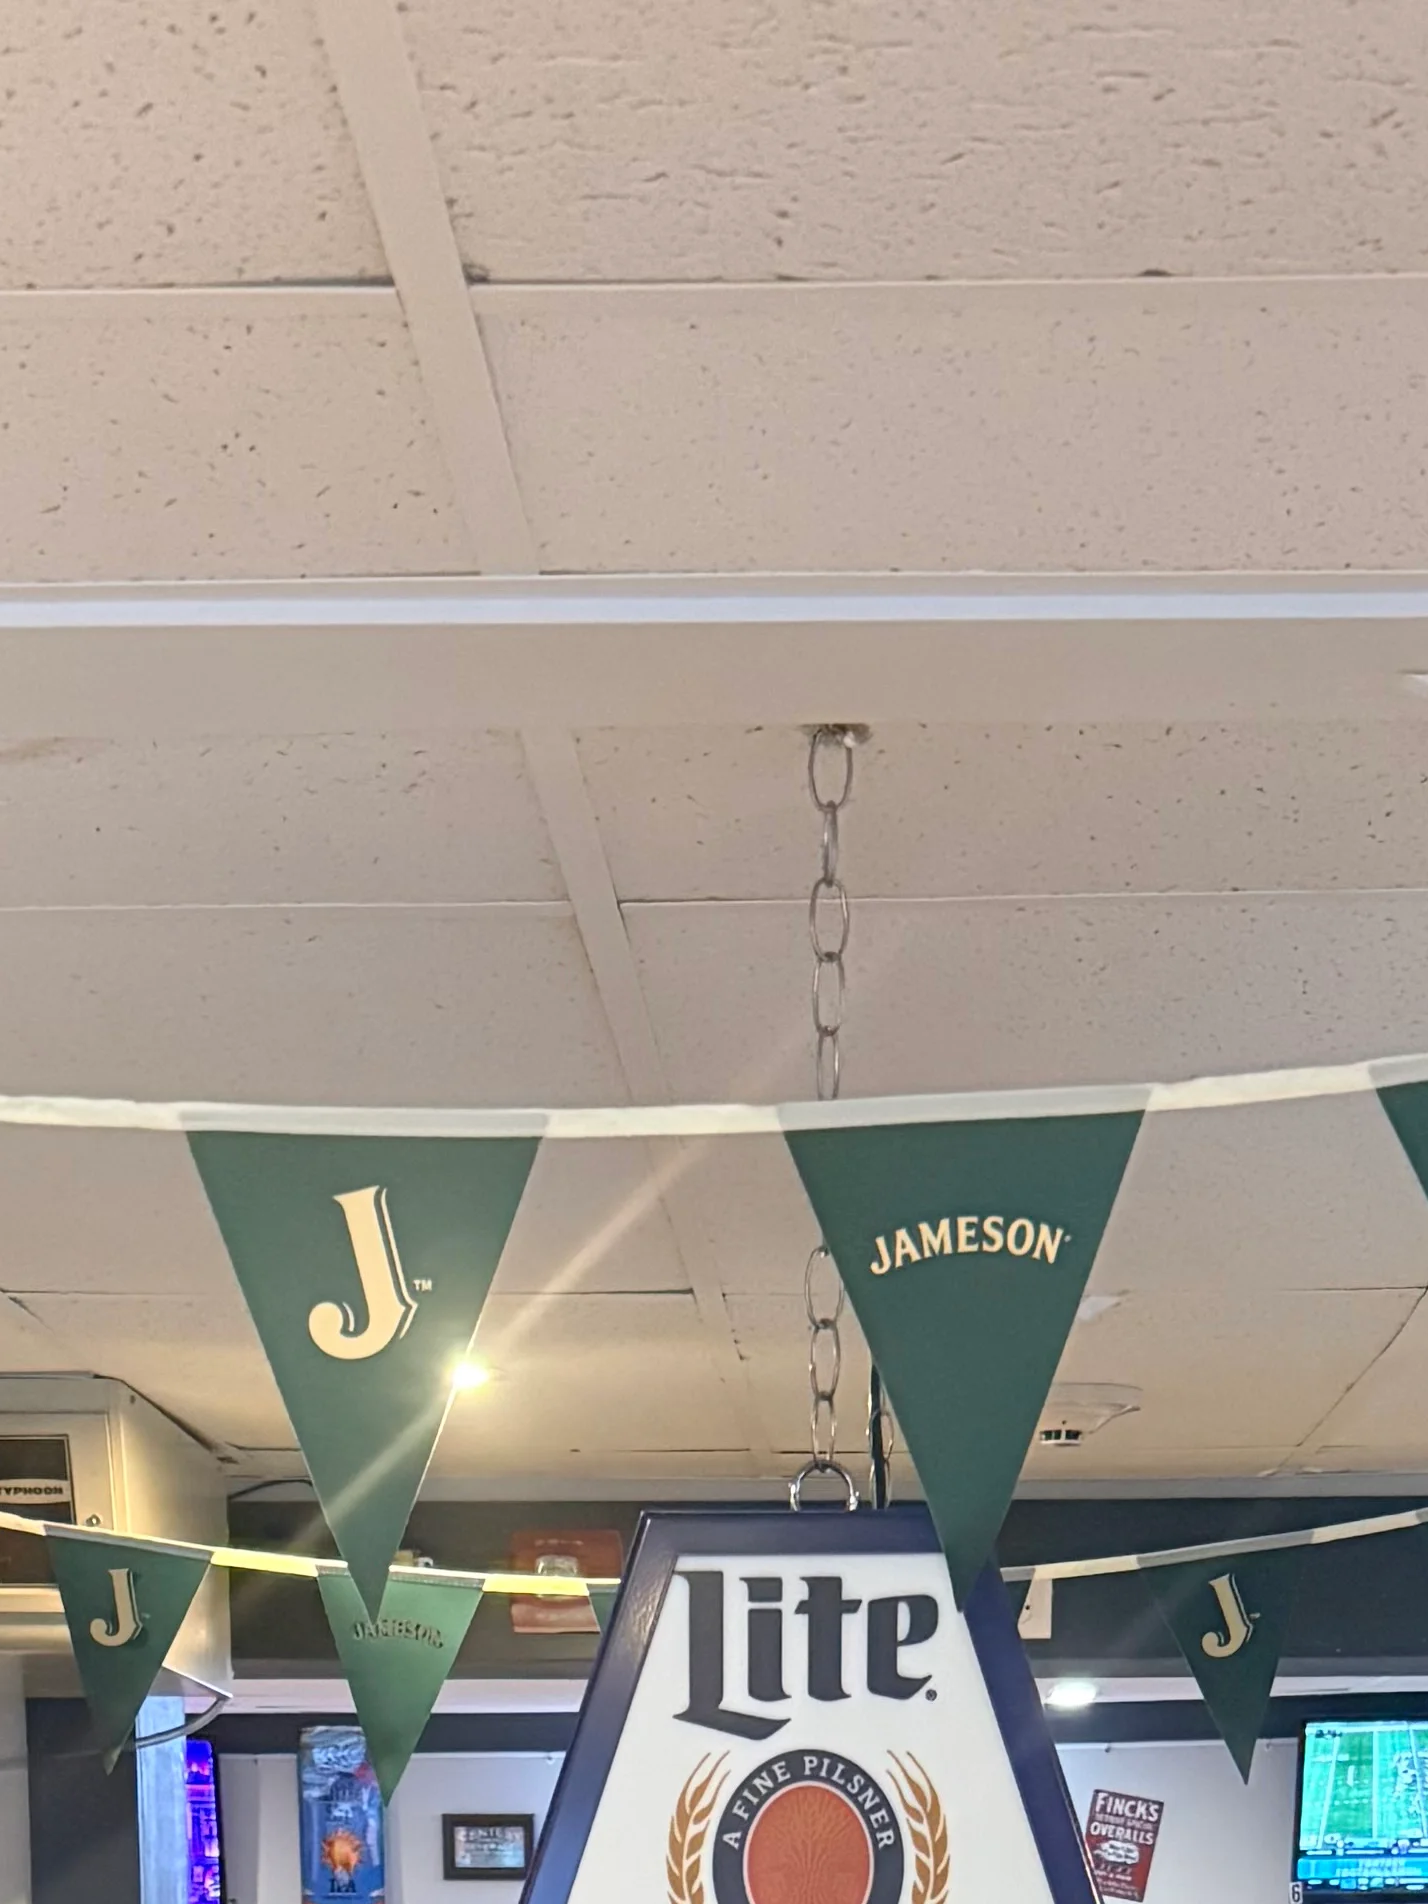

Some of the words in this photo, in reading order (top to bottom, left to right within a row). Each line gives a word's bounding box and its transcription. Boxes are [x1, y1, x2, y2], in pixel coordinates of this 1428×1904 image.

[309, 1185, 418, 1361] J
[870, 1215, 1067, 1275] JAMESON
[90, 1568, 143, 1647] J
[1201, 1574, 1256, 1659] J
[672, 1570, 939, 1740] Lite
[729, 1758, 793, 1822] FINE
[803, 1755, 896, 1850] PILSNER
[1095, 1792, 1160, 1822] FINCK'S
[722, 1829, 741, 1850] A
[1090, 1822, 1154, 1845] OVERALLS
[1290, 1884, 1301, 1903] 6
